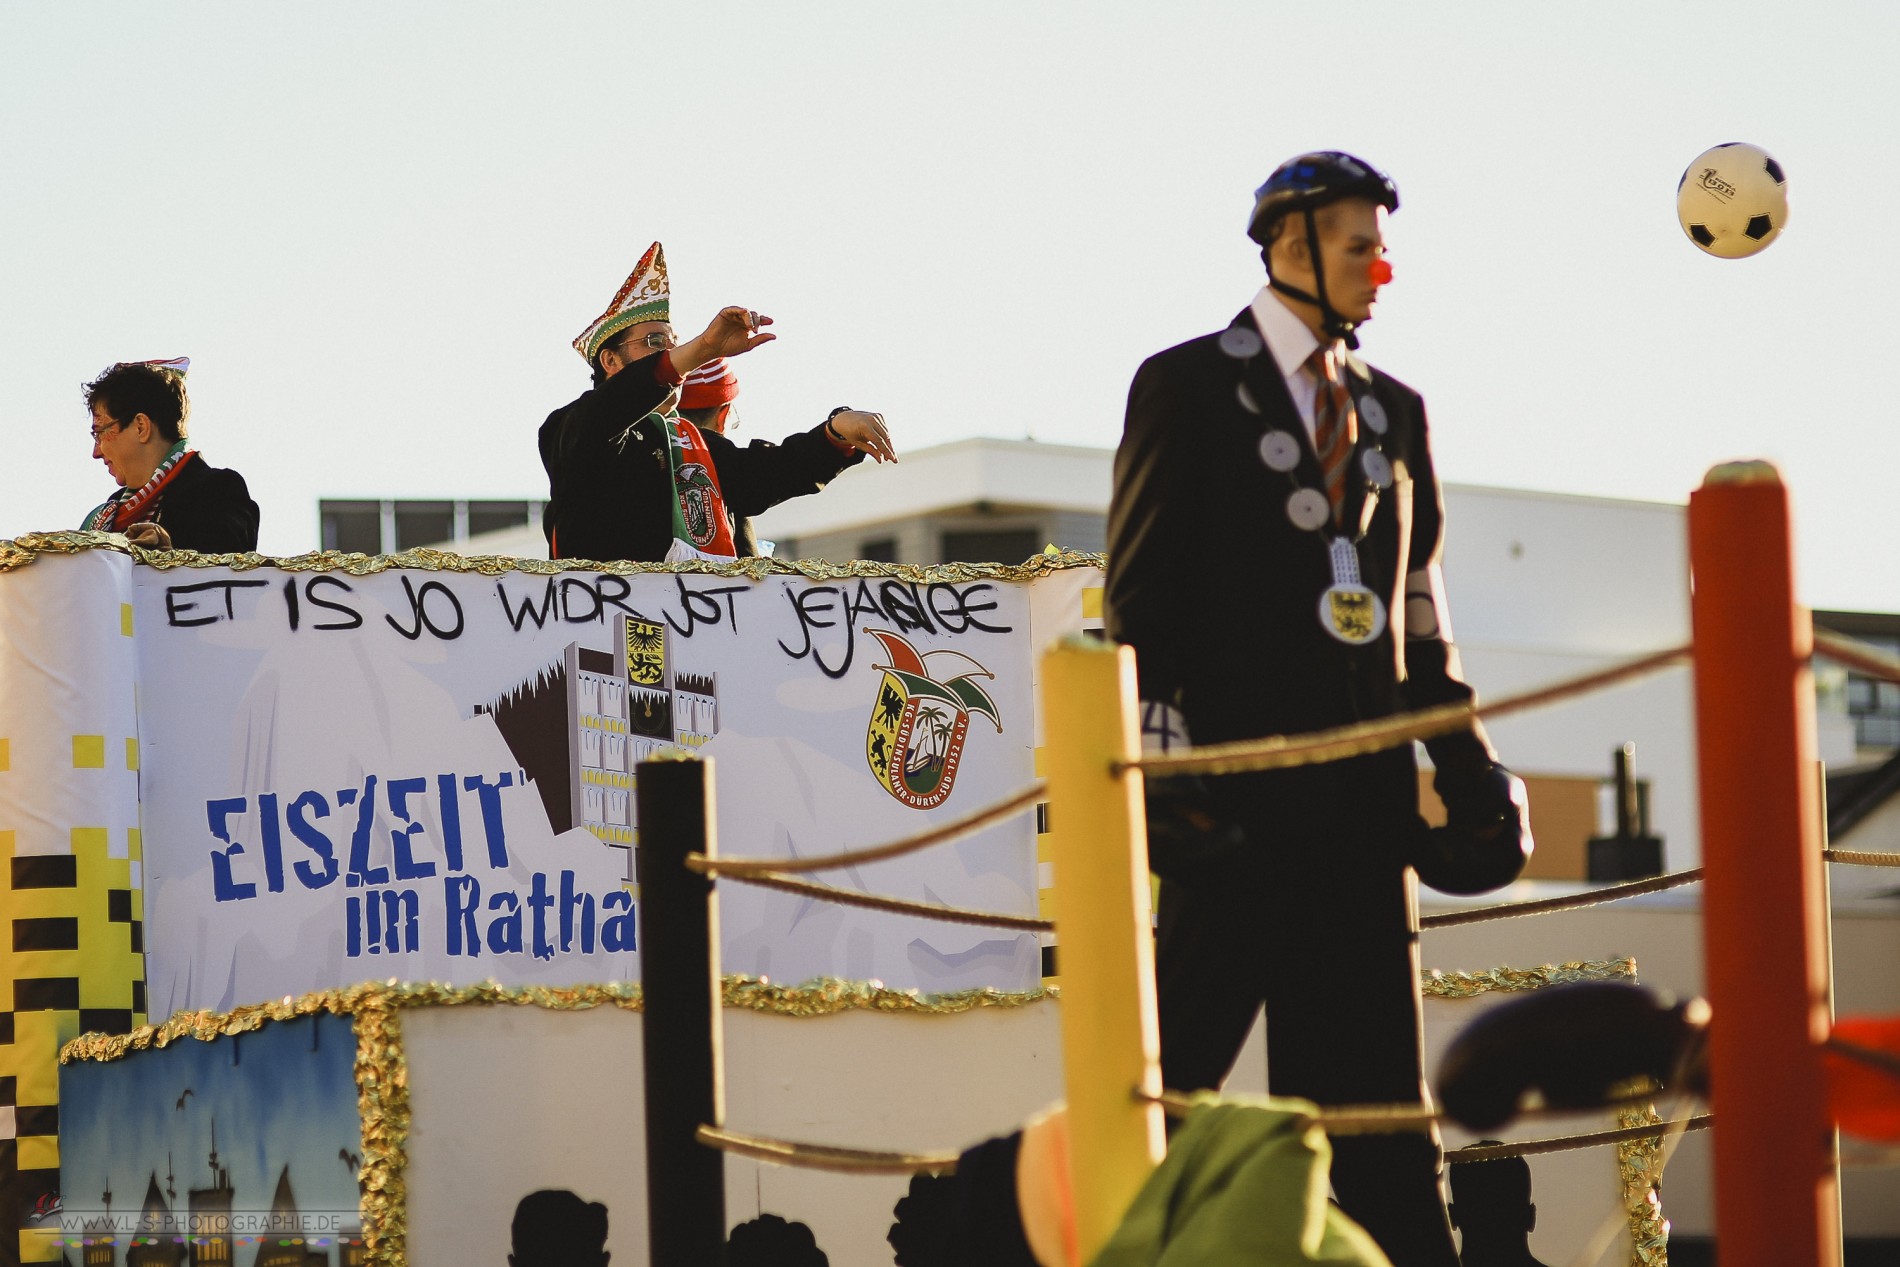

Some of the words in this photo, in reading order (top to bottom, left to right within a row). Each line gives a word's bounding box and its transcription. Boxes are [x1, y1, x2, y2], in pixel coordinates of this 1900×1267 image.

[165, 579, 269, 628] ET
[283, 575, 364, 632] IS
[385, 574, 465, 640] JO
[496, 574, 644, 632] WIDR
[661, 573, 751, 639] JOT
[905, 704, 915, 718] KG
[957, 718, 967, 740] e.V.
[890, 723, 909, 799] SÜDINSULANER
[947, 744, 961, 771] 1952
[939, 775, 953, 795] SÜD
[909, 794, 941, 807] DÜREN
[206, 771, 517, 902] EISZEIT
[444, 869, 638, 961] Ratha
